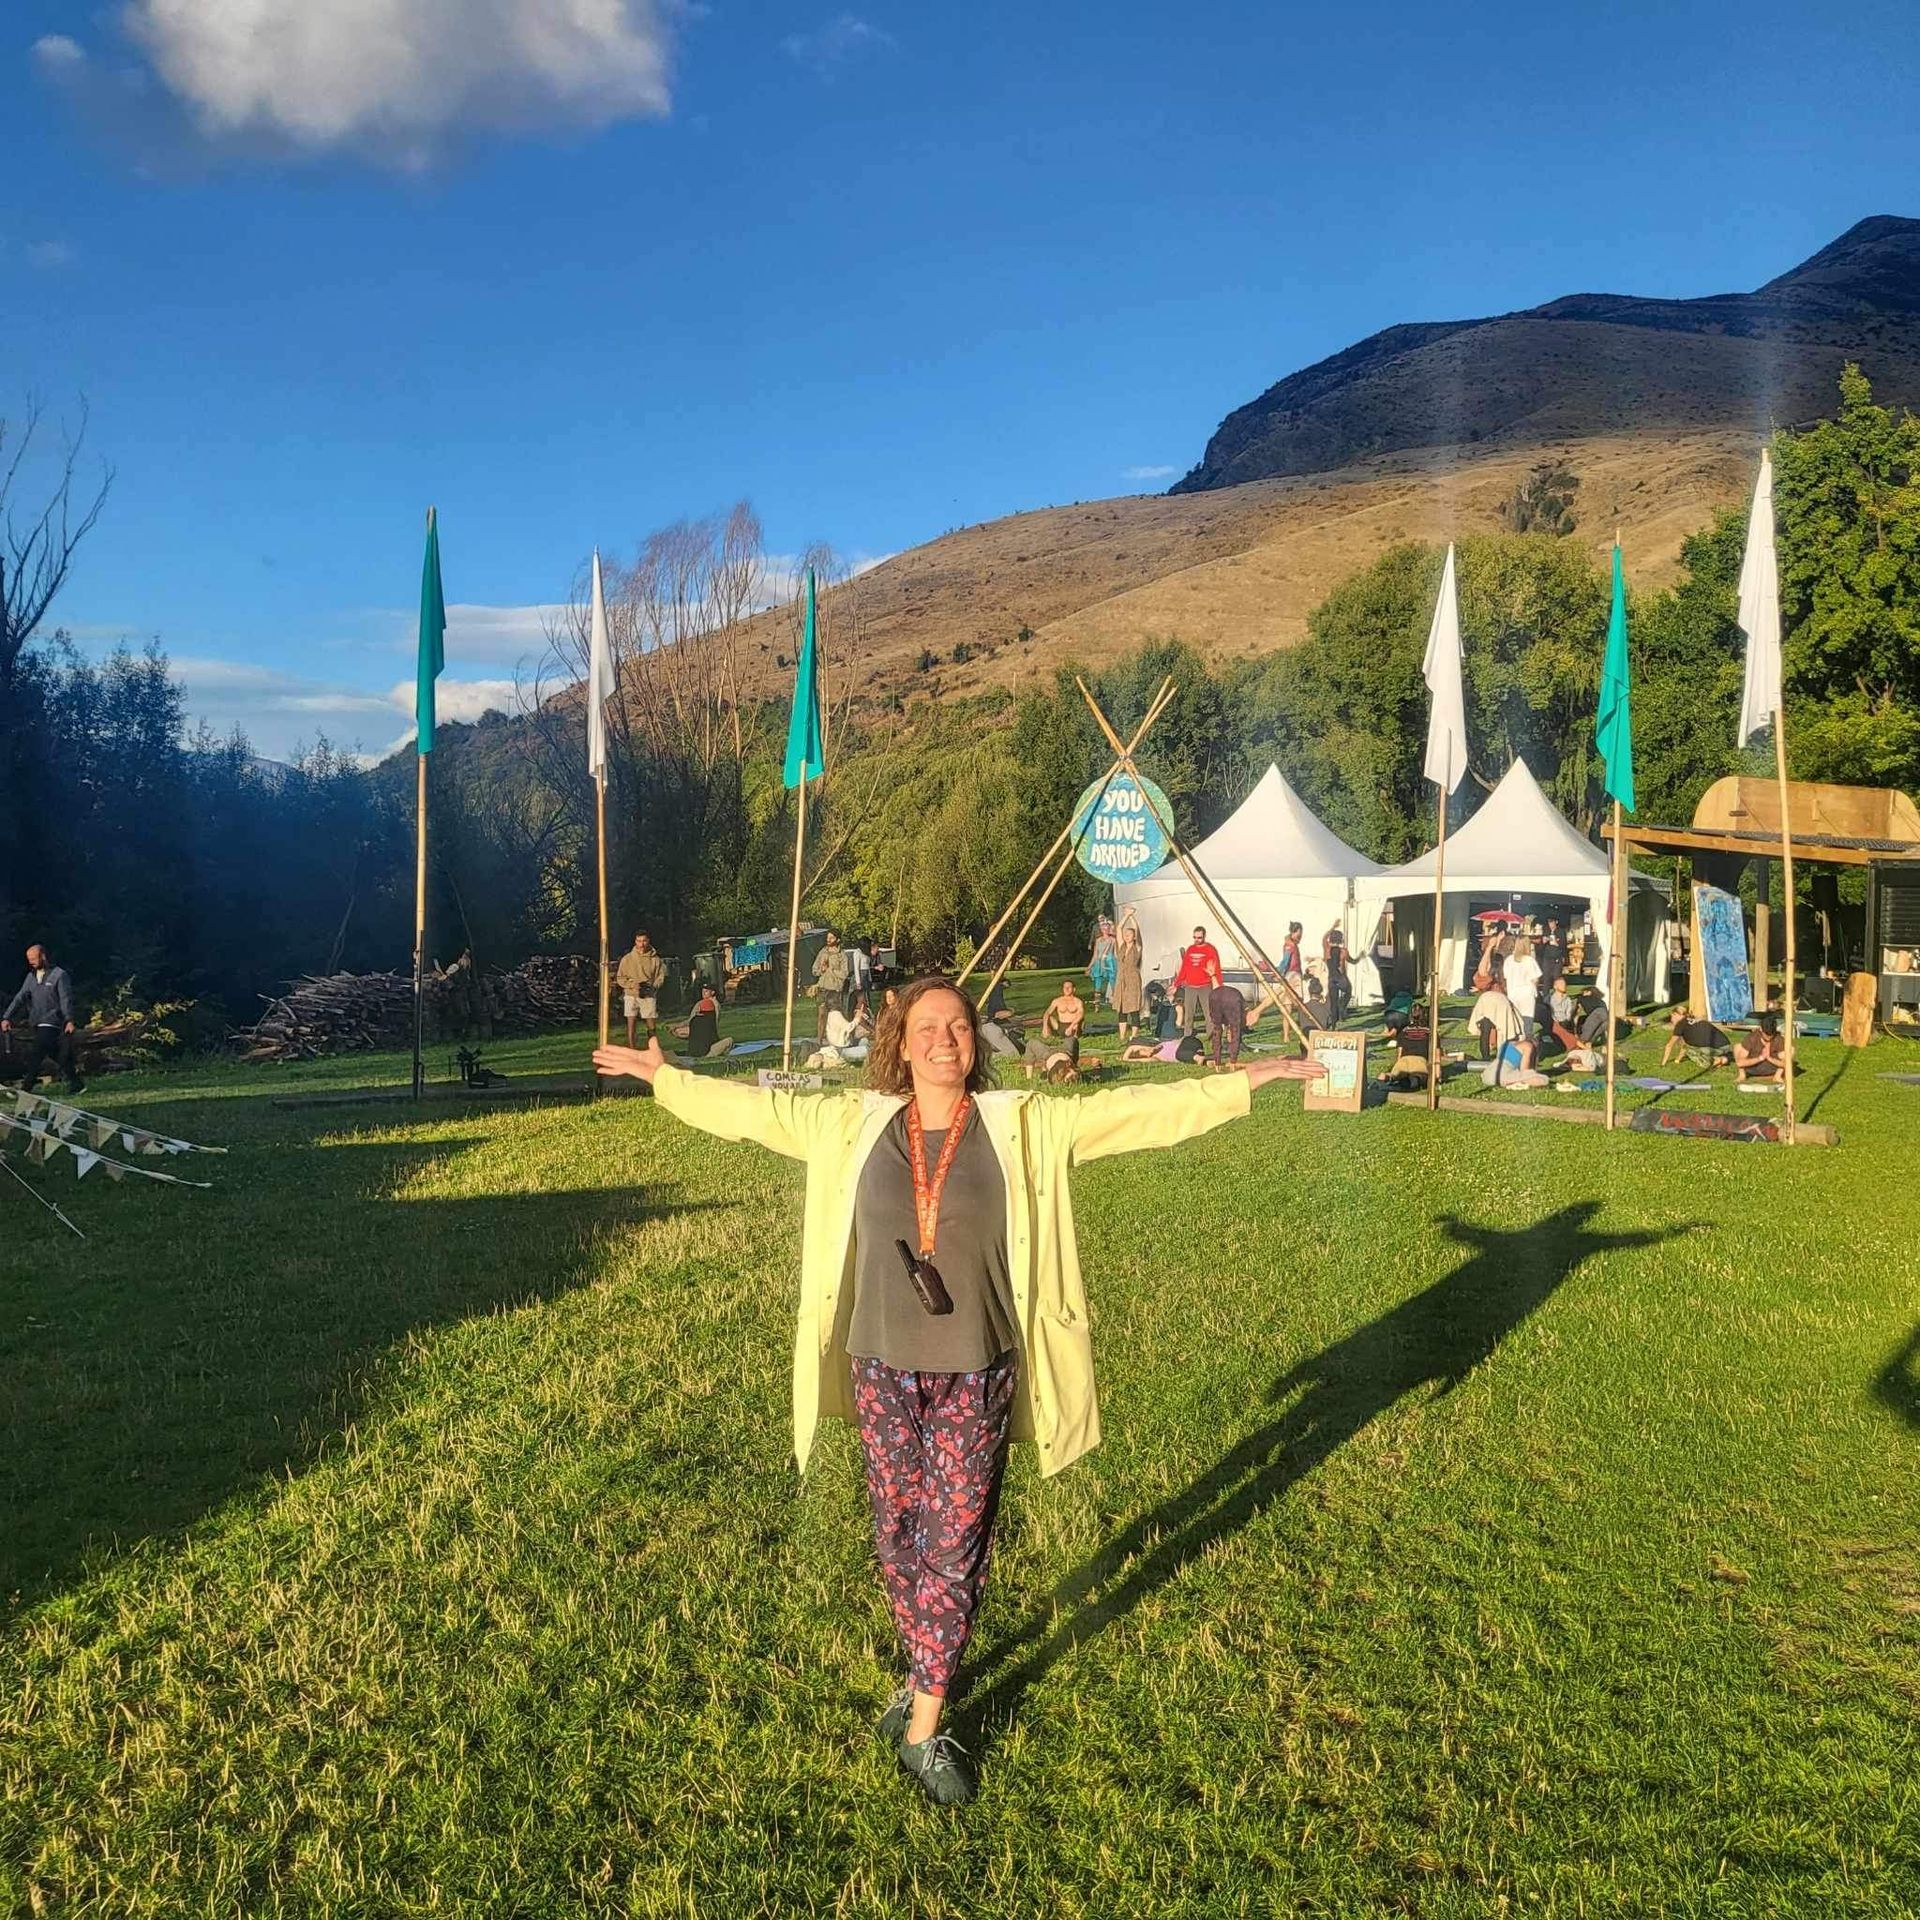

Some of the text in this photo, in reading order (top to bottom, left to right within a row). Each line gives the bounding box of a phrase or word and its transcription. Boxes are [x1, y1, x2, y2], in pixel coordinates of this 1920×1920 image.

[1102, 789, 1144, 813] YOU
[1095, 816, 1145, 842] HAVE
[1091, 843, 1150, 868] ARRIVED
[766, 1072, 795, 1081] COME
